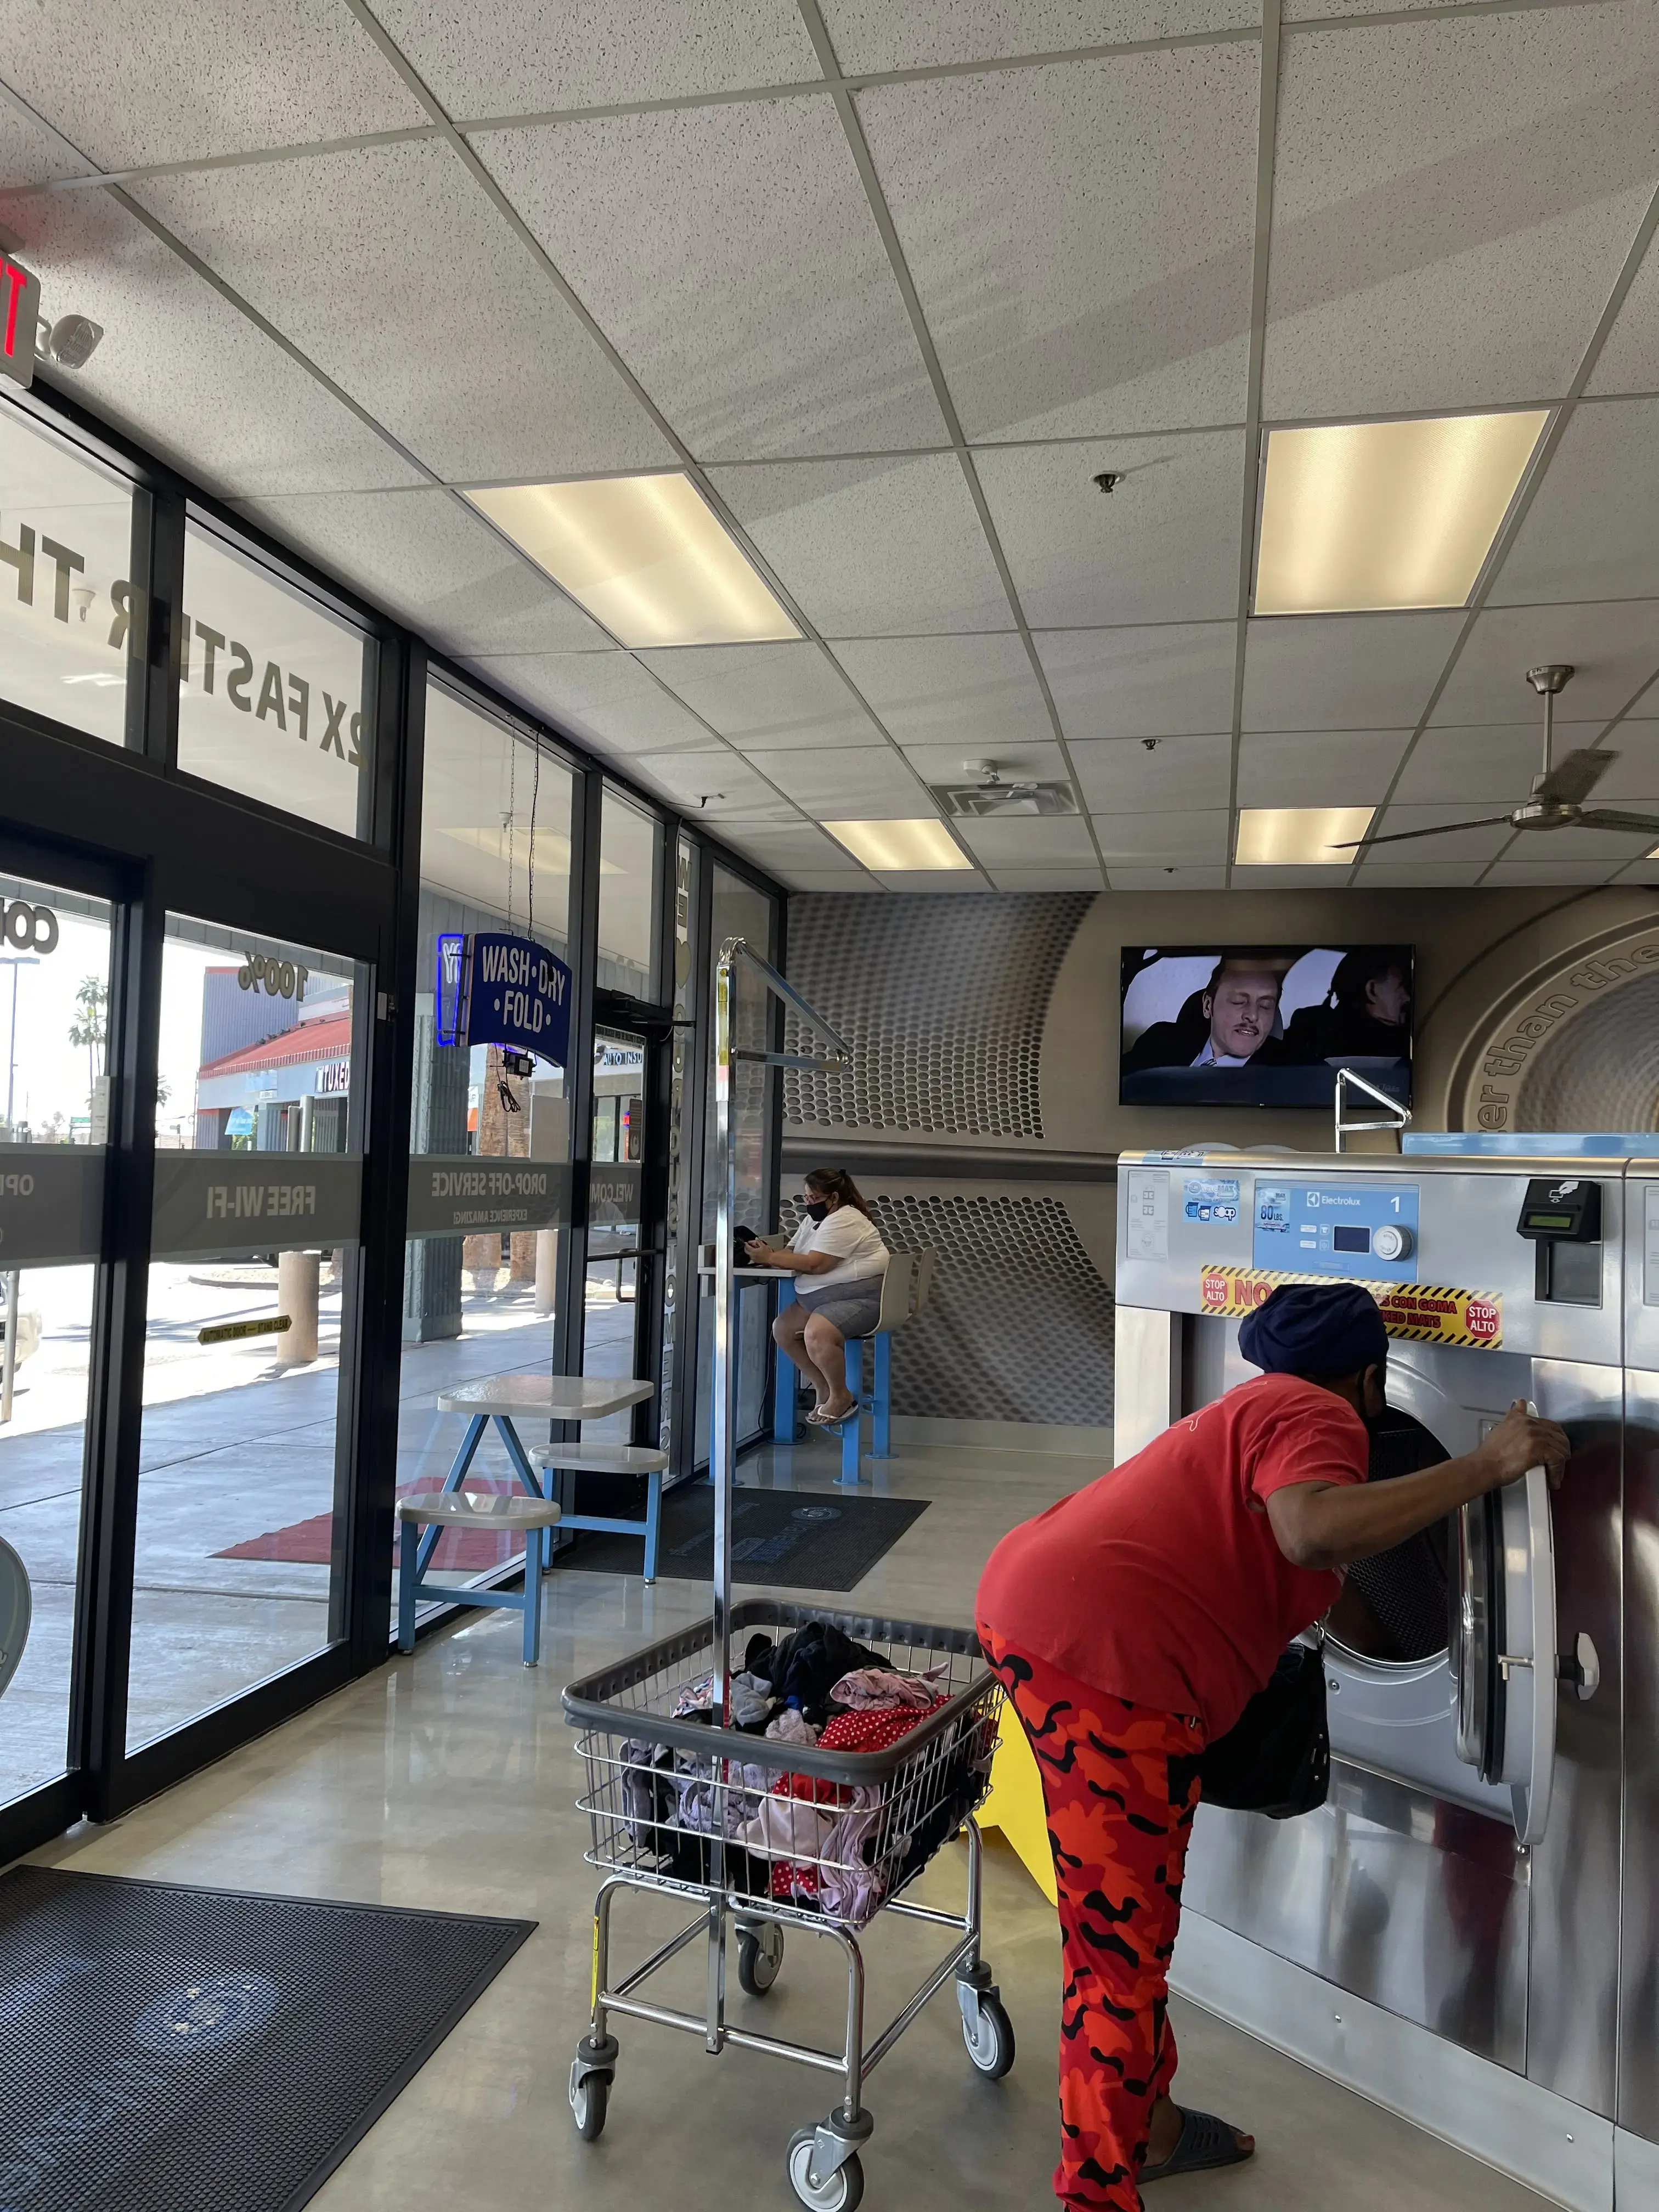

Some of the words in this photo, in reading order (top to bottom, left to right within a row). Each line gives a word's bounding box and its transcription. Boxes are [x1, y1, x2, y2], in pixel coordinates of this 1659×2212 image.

[1484, 994, 1578, 1076] than
[1570, 945, 1659, 990] the
[603, 1053, 622, 1065] AUTO
[1322, 1195, 1361, 1206] Electrolux
[1390, 1196, 1400, 1213] 1
[1261, 1205, 1273, 1221] 80
[1205, 1279, 1226, 1289] STOP
[1206, 1291, 1225, 1302] ALTO
[1391, 1296, 1417, 1310] CON
[1418, 1299, 1458, 1314] GOMA
[1469, 1306, 1497, 1319] STOP
[1407, 1312, 1441, 1329] MATS
[1470, 1319, 1496, 1333] ALTO
